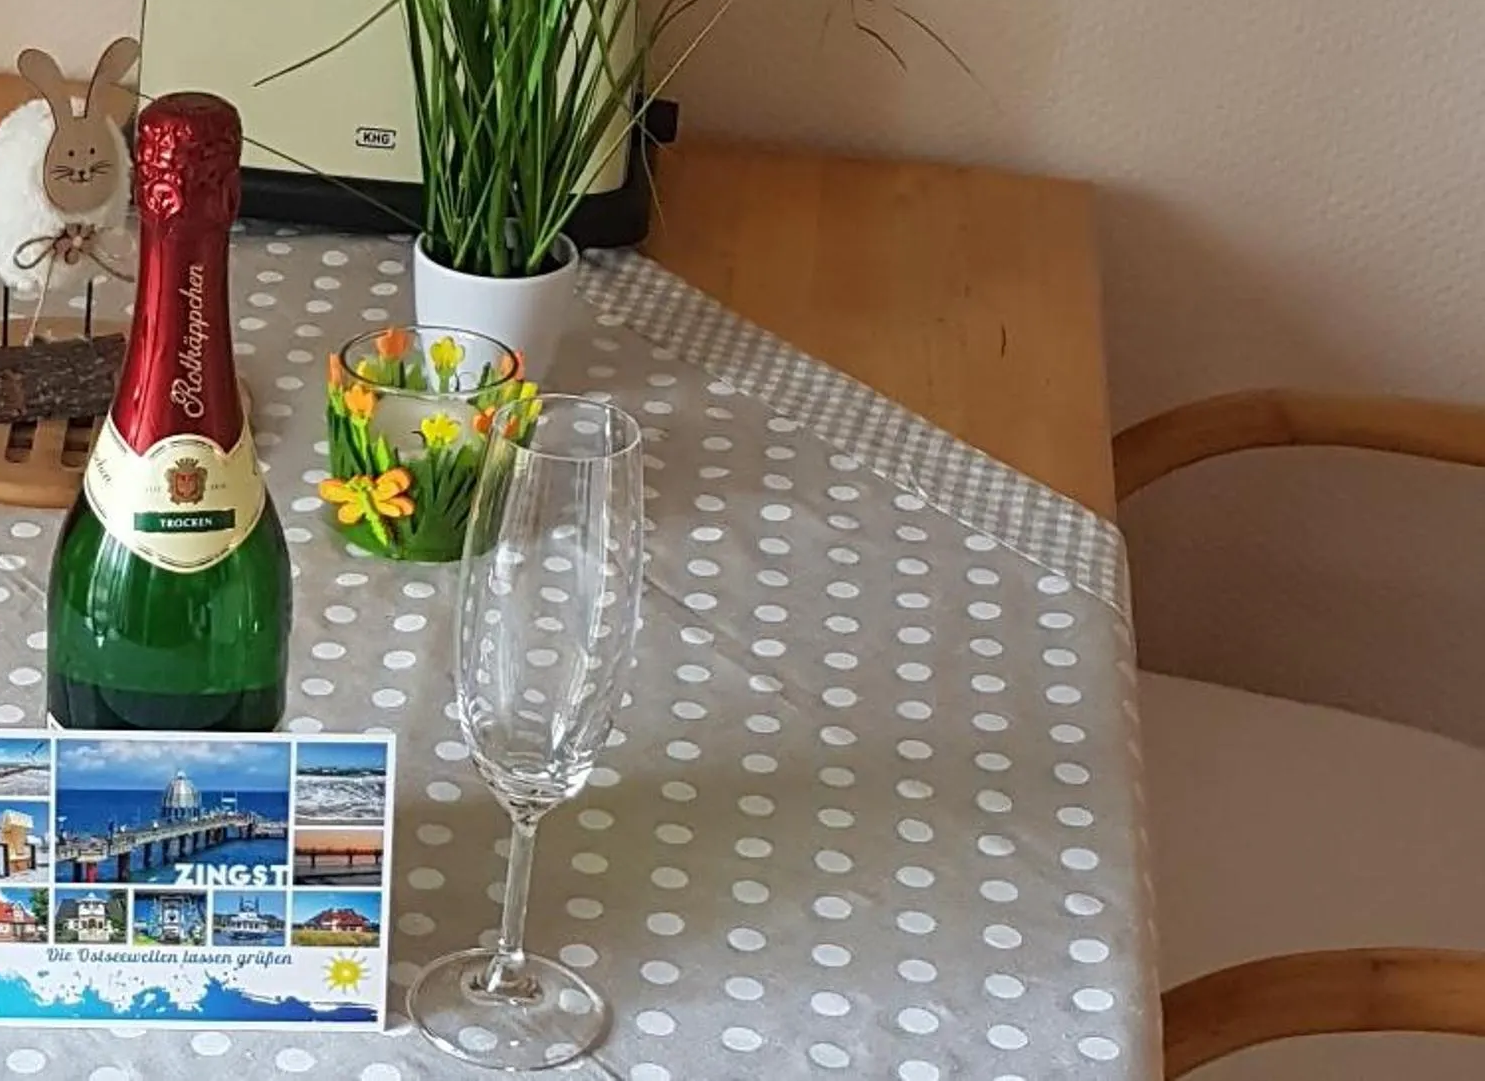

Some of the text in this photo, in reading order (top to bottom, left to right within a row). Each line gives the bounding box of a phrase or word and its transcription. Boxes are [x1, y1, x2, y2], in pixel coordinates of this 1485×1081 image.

[362, 131, 390, 144] KHG
[160, 518, 212, 528] TROCKEN
[174, 863, 290, 886] ZINGST
[46, 948, 292, 969] Die Ostseewellen lassen grüßen
